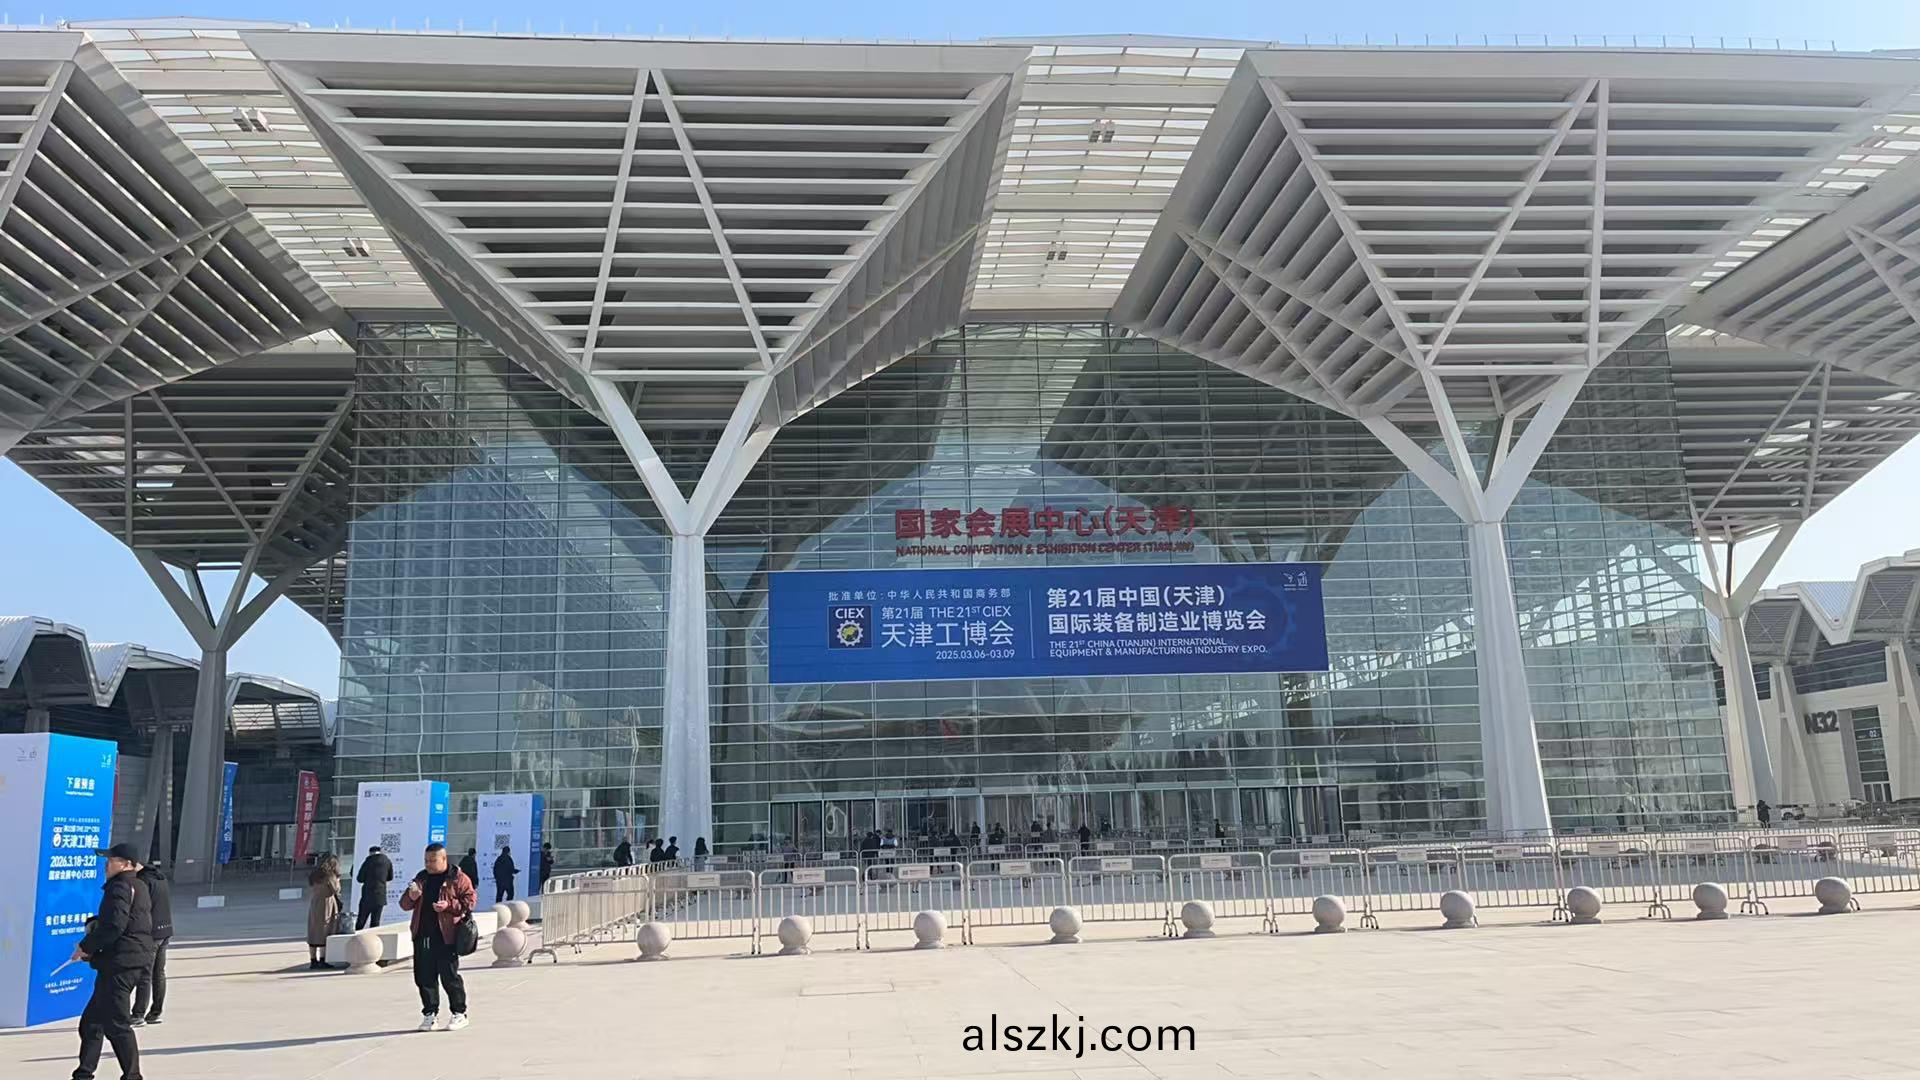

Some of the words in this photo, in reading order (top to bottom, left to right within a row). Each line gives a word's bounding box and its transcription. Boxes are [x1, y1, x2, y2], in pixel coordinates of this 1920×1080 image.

[895, 505, 1195, 539] 国家会展中心(天津)
[896, 545, 950, 557] NATIONAL
[953, 544, 1023, 555] CONVENTION
[1026, 544, 1033, 554] &
[1047, 585, 1225, 608] 第21届中国(天津)
[835, 608, 865, 619] CIEX
[881, 606, 923, 620] 第21届
[929, 607, 954, 618] THE
[957, 606, 980, 618] 21ST
[982, 606, 1011, 617] CIEX
[1048, 609, 1266, 634] 国际装备制造业博览会
[881, 620, 1014, 648] 天津工博会
[1049, 641, 1066, 649] THE
[1087, 640, 1115, 648] CHINA
[1116, 638, 1156, 648] (TIANJIN)
[1158, 638, 1227, 646] INTERNATIONAL
[936, 649, 1015, 660] 2025.03.06-03.09
[1049, 648, 1103, 658] EQUIPMENT
[1105, 648, 1112, 656] &
[1114, 646, 1193, 656] MANUFACTURING
[1194, 645, 1239, 654] INDUSTRY
[1241, 645, 1268, 653] EXPO.
[1804, 710, 1839, 734] N32
[62, 834, 99, 848] 天津工博会
[50, 855, 97, 867] 2026.3.18-3.21
